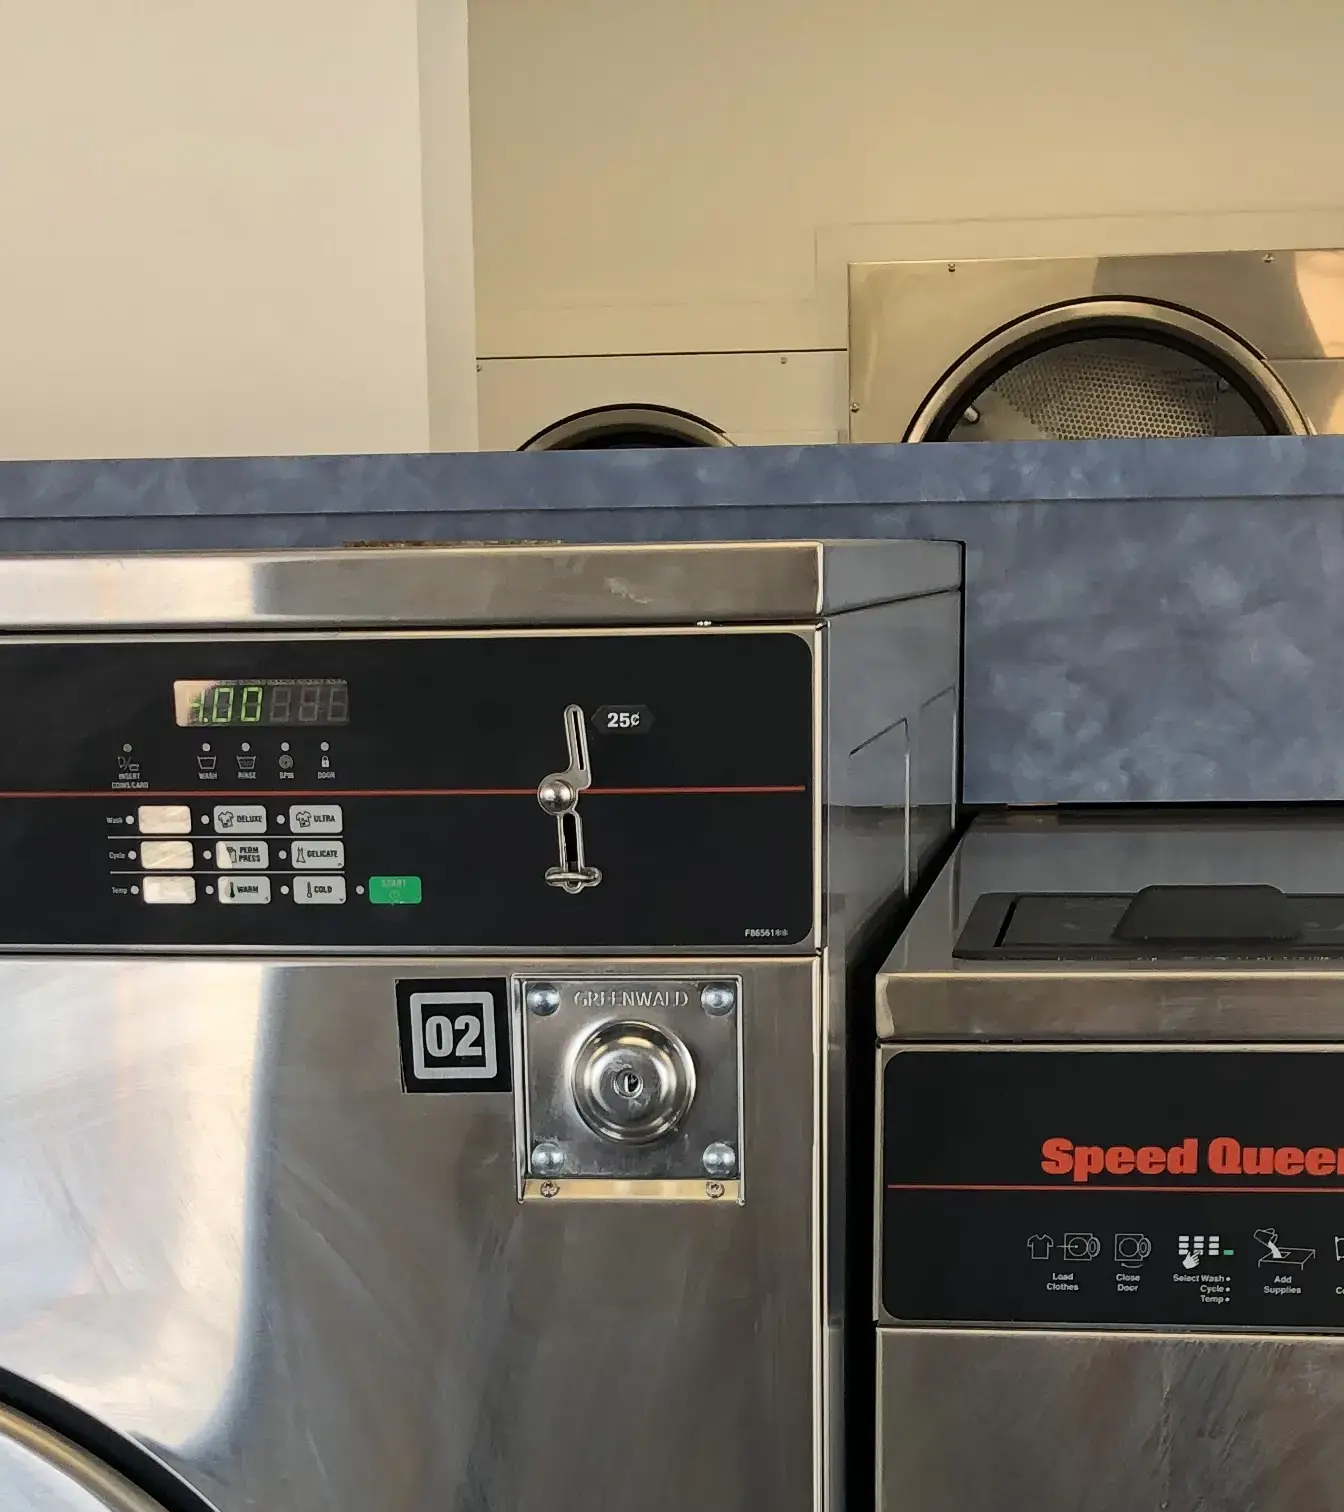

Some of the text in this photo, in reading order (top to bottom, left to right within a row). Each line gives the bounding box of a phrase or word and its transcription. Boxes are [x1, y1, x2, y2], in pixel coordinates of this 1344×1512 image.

[607, 712, 640, 729] 25¢
[237, 815, 263, 823] DELUXE
[314, 815, 336, 823] ULTRA
[307, 850, 338, 858] DELICATE
[238, 855, 260, 863] PRESS
[237, 885, 258, 893] WARM
[314, 885, 332, 893] COLD
[573, 990, 689, 1007] GREENWALD
[425, 1015, 482, 1057] 02
[1041, 1137, 1198, 1182] Speed
[1052, 1273, 1074, 1281] Load
[1116, 1273, 1140, 1282] Close
[1173, 1274, 1199, 1282] Select
[1046, 1283, 1079, 1291] Clothes
[1117, 1284, 1138, 1292] Door
[1199, 1285, 1225, 1294] Cycle
[1263, 1286, 1302, 1295] Supplies
[1200, 1295, 1224, 1304] Temp
